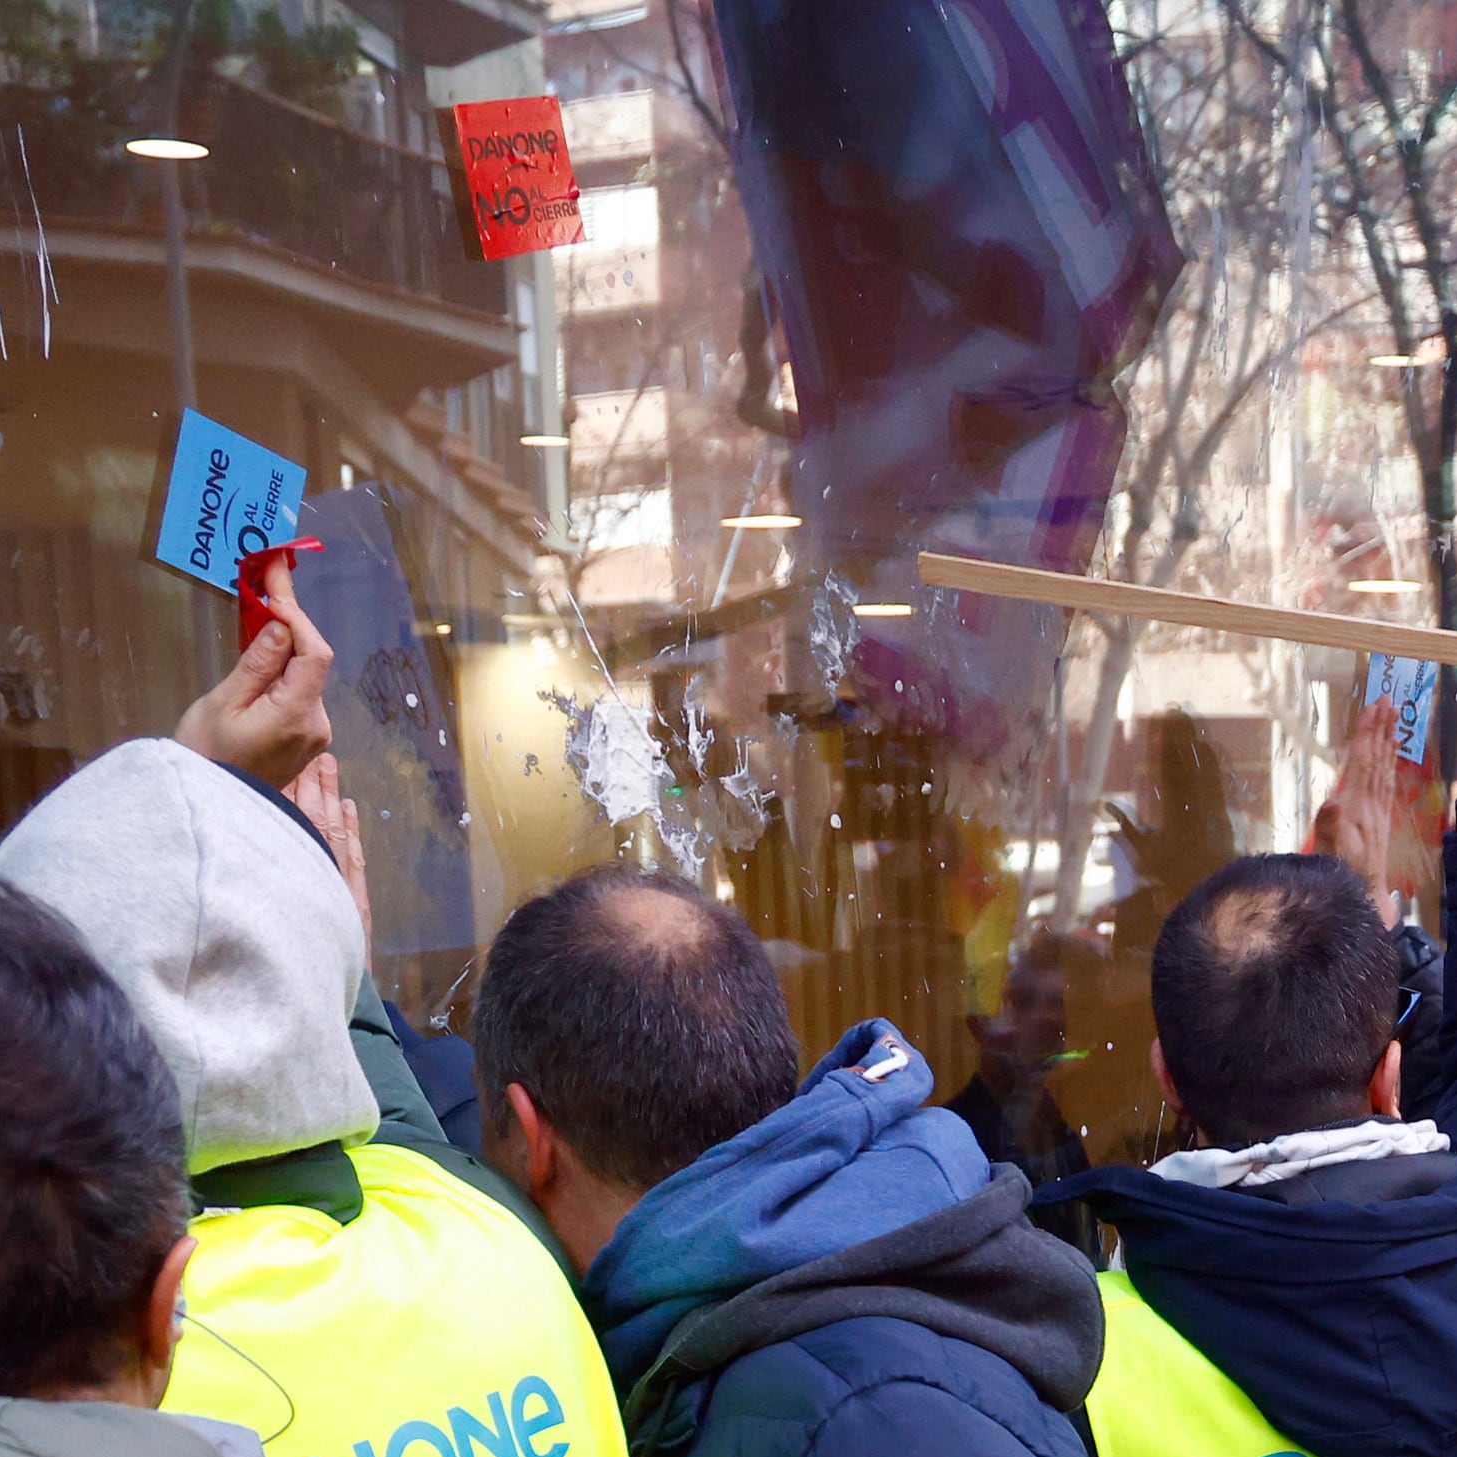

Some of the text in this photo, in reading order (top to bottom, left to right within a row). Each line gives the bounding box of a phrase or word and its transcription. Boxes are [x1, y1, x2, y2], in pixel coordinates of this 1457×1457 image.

[475, 186, 531, 230] NO
[244, 501, 258, 524] AL
[262, 469, 284, 531] CIERRE
[1398, 700, 1418, 754] NO
